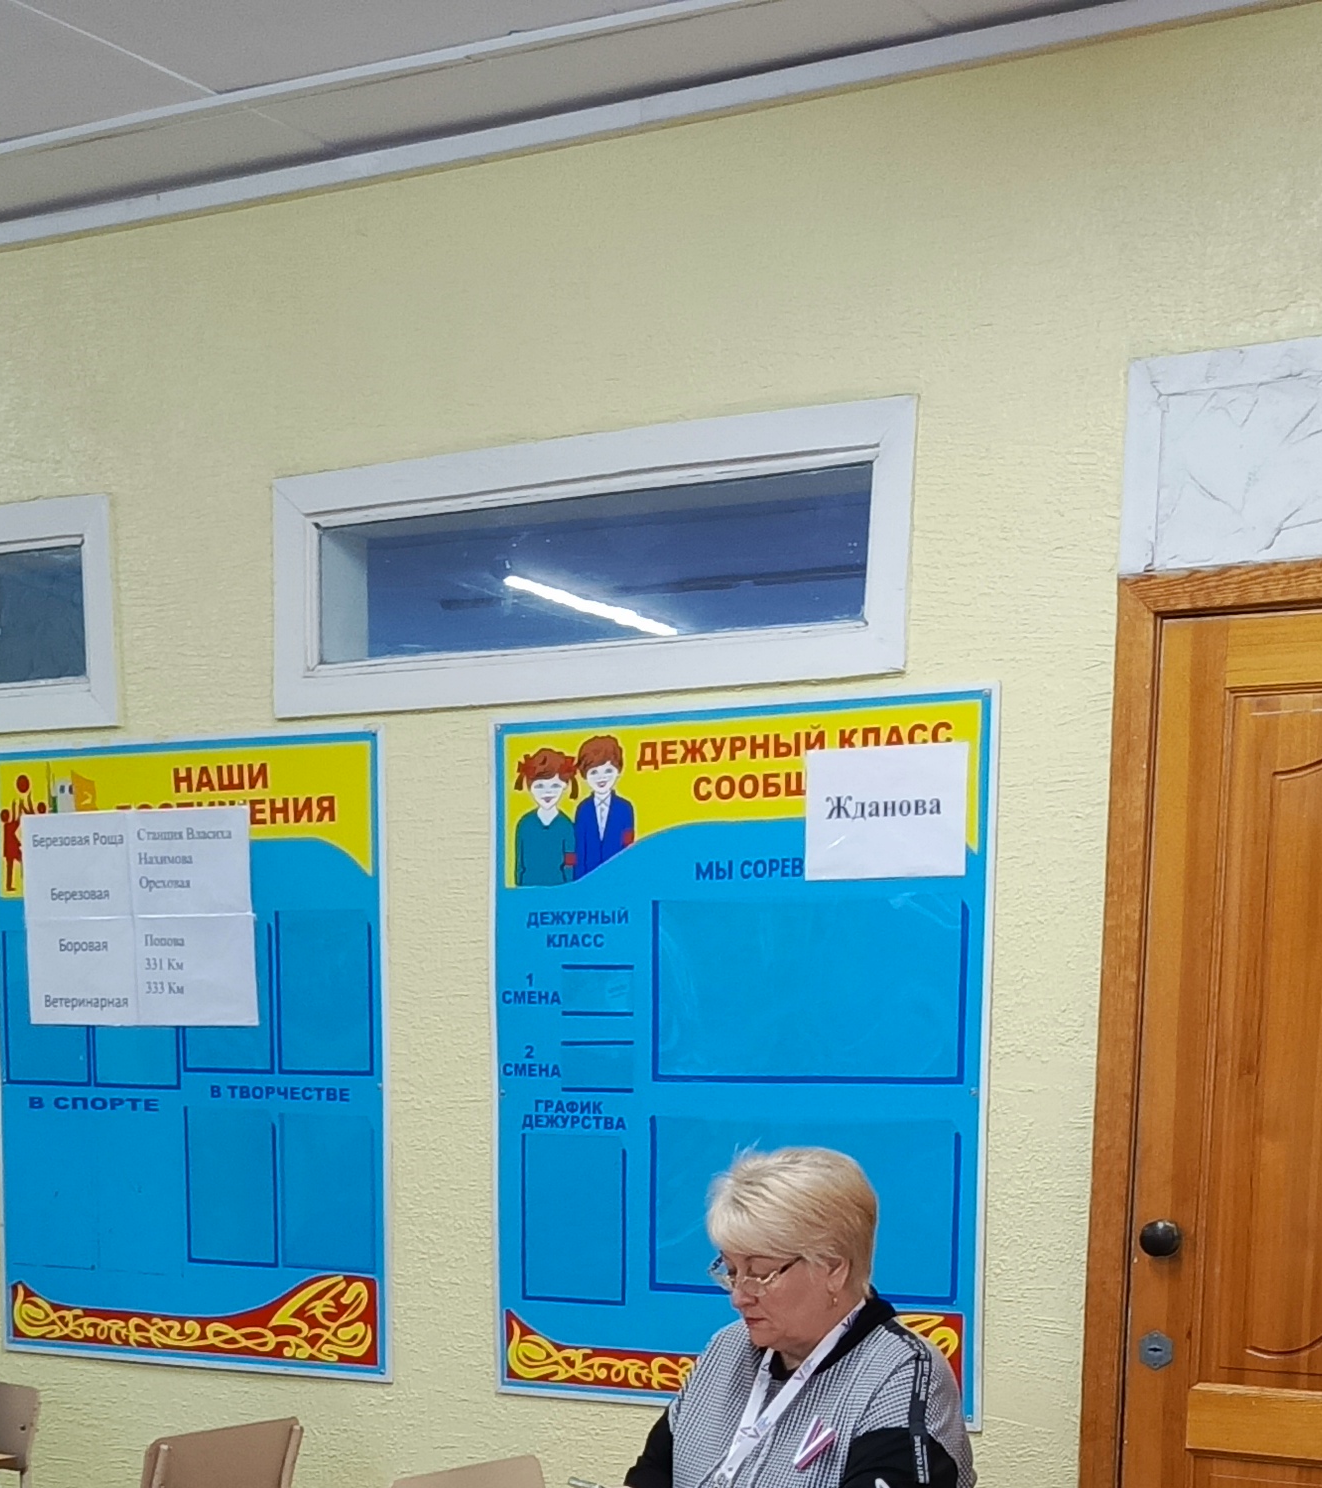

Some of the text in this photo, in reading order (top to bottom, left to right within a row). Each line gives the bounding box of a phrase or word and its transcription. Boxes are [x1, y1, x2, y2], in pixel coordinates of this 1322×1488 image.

[636, 724, 825, 771] ДЕЖУРНЫЙ
[173, 763, 269, 794] НАШИ
[825, 795, 942, 821] Жданова
[32, 832, 124, 849] Березовая Роща
[136, 828, 184, 841] Станция
[138, 852, 193, 865] Нахимова
[695, 861, 733, 881] МЫ
[50, 888, 110, 903] Березовая
[527, 907, 628, 928] ДЕЖУРНЫЙ
[59, 938, 109, 955] Боровая
[546, 933, 605, 948] КЛАСС
[145, 958, 184, 971] 331 Км
[526, 973, 533, 987] 1
[145, 982, 184, 994] 333 Км
[44, 994, 129, 1011] Ветеринарная
[501, 990, 561, 1005] СМЕНА
[525, 1045, 534, 1059] 2
[502, 1063, 561, 1077] СМЕНА
[210, 1085, 350, 1102] В ТВОРЧЕСТВЕ
[28, 1097, 159, 1112] В СПОРТЕ
[534, 1099, 603, 1115] ГРАФИК
[521, 1114, 627, 1130] ДЕЖУРСТВА
